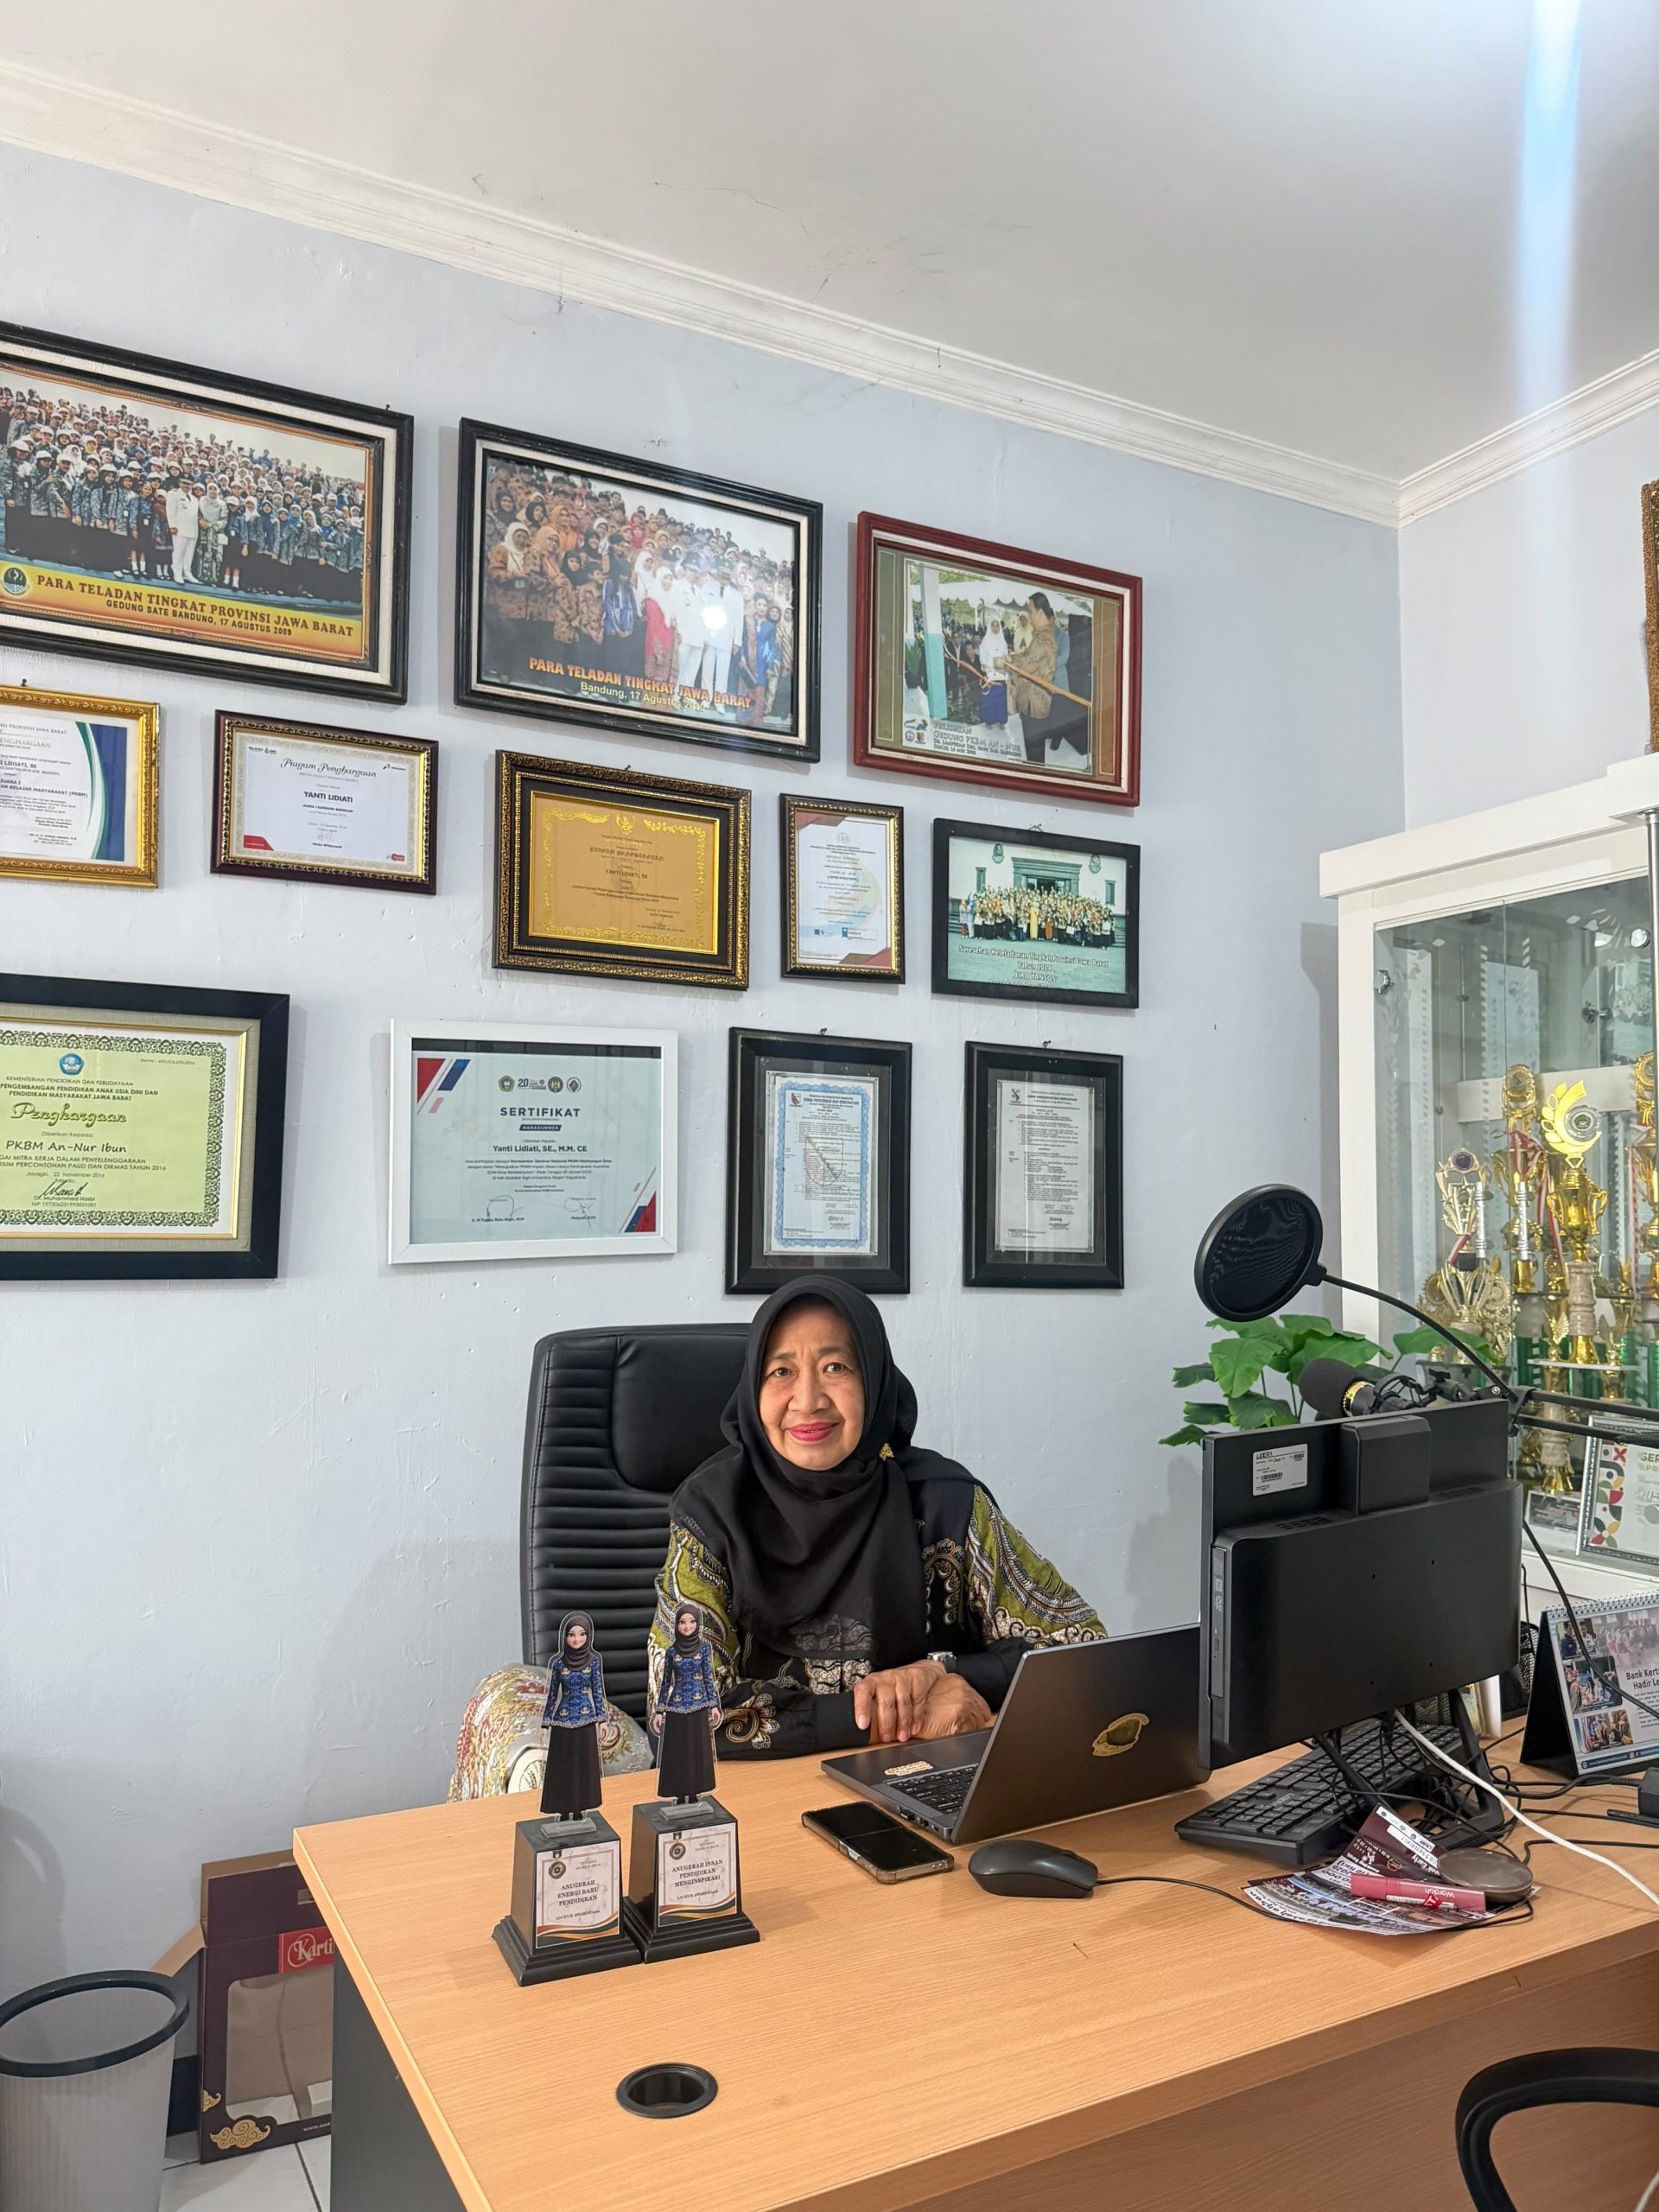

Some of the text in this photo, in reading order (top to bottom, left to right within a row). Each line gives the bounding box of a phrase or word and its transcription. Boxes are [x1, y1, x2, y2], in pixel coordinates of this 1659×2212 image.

[36, 575, 353, 637] PARA TELADAN TINGKAT PROVINSI JAWA BARAT
[106, 600, 143, 613] GEDUNG
[147, 605, 169, 617] SATE
[172, 610, 216, 626] BANDUNG,
[232, 620, 270, 633] AGUSTUS
[529, 658, 751, 708] PARA TELADAN TINGKAT JAWA BARAT
[581, 682, 627, 701] Bandung,
[630, 690, 639, 699] 17
[281, 758, 316, 771] Piagam
[318, 762, 377, 778] Penghargaan
[304, 791, 353, 803] YANTI LIDIATI
[0, 1083, 55, 1091] PENGEMBANGAN
[10, 1103, 127, 1128] Penghargaan
[500, 1108, 581, 1117] SERTIFIKAT
[6, 1141, 126, 1153] PKBM An-Nur Ibun
[1626, 1671, 1643, 1680] Bank
[1633, 1680, 1651, 1689] Hadir
[672, 1862, 704, 1872] ANUGERAH
[679, 1868, 716, 1878] PENDIDIKAN
[561, 1880, 595, 1890] ANUGERAH
[675, 1875, 720, 1887] MENGINSPIRASI
[1425, 1887, 1455, 1898] Wardah
[559, 1895, 597, 1906] PENDIDIKAN
